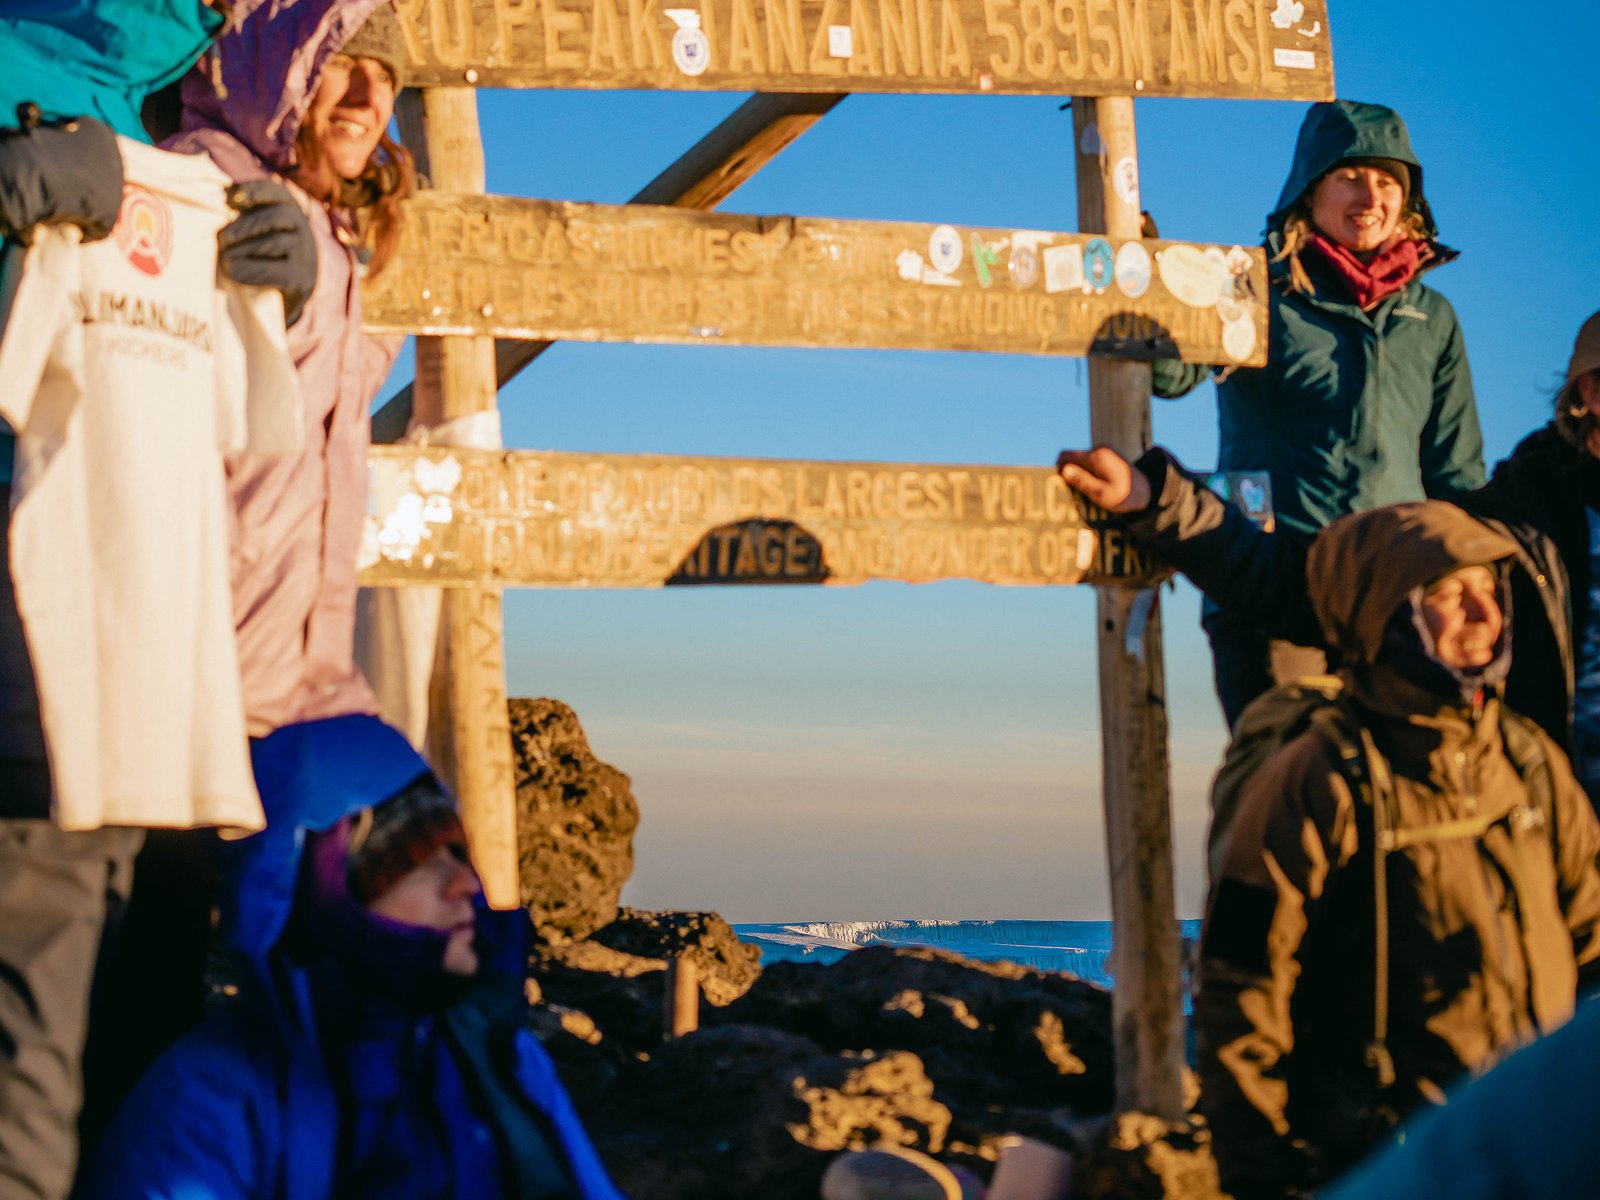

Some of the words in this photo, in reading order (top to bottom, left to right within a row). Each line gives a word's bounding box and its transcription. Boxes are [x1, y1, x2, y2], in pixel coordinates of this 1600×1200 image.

[794, 465, 970, 520] LARGEST
[901, 525, 1033, 577] WONDER
[1038, 527, 1080, 576] OF
